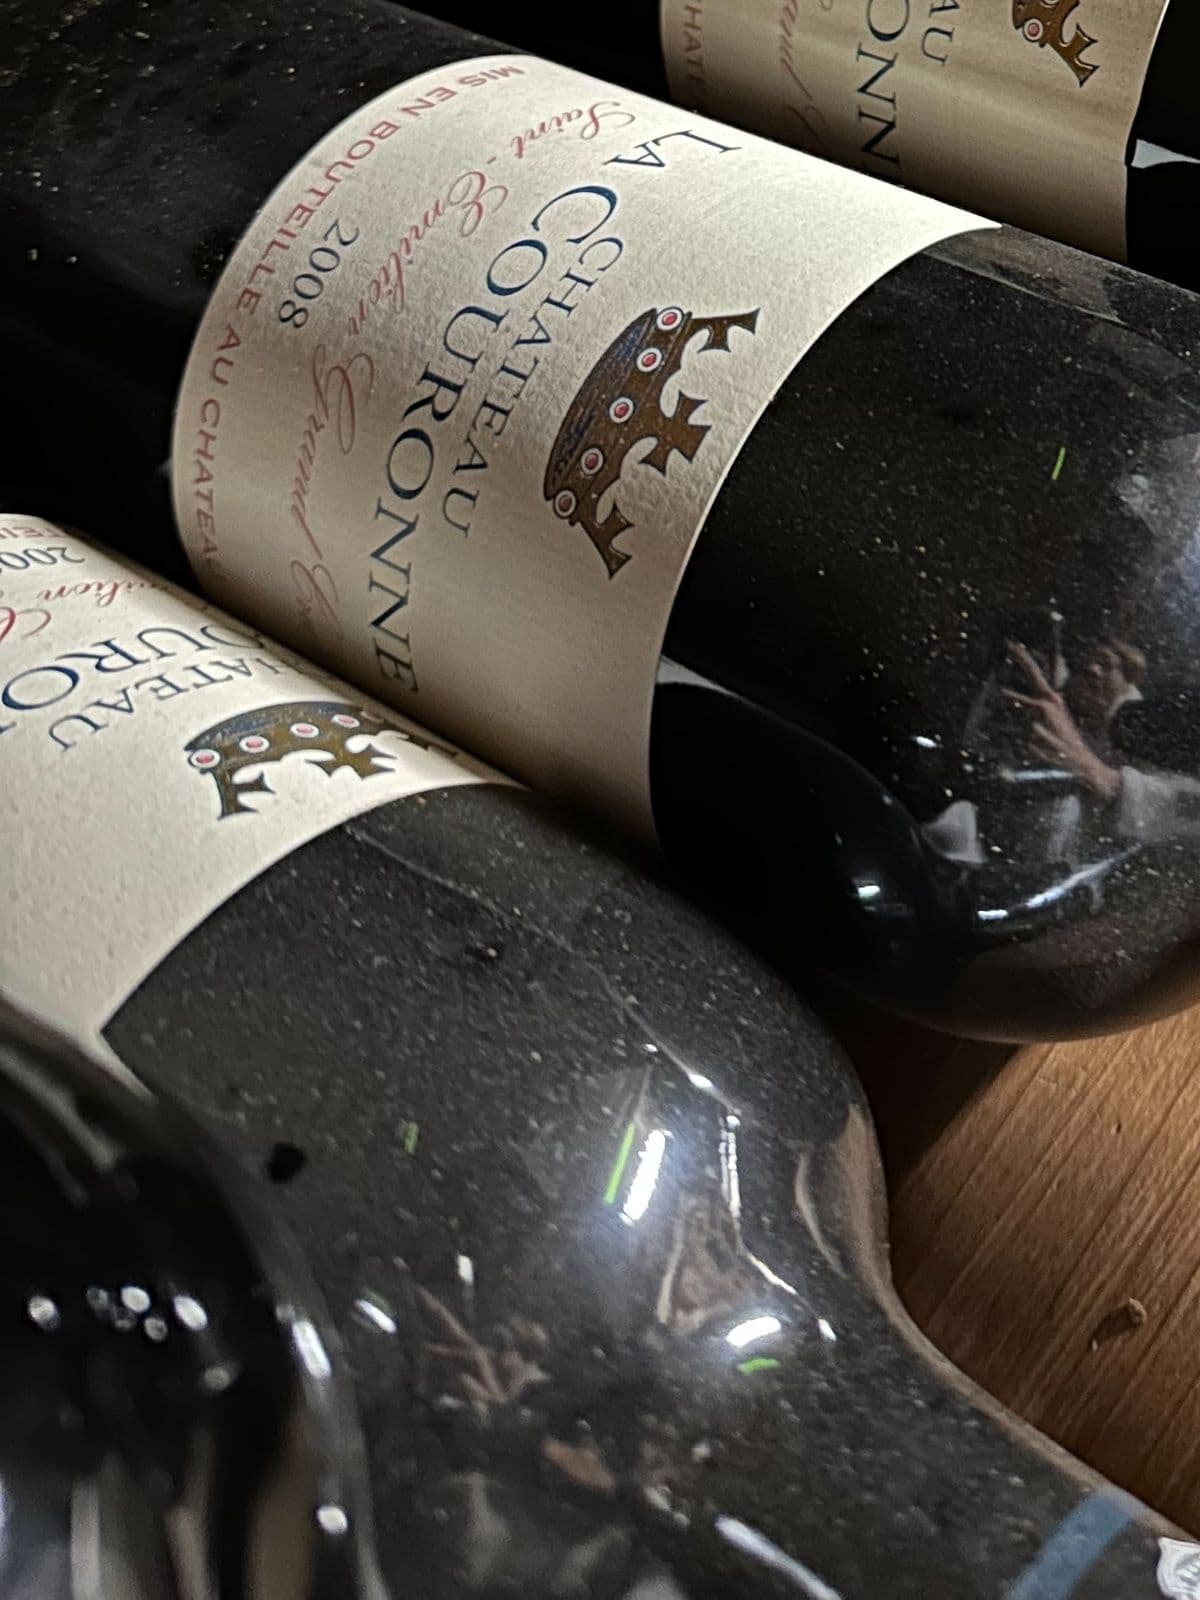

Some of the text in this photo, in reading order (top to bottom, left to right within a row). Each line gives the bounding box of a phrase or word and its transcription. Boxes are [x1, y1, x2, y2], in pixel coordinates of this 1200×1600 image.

[400, 84, 459, 119] EN
[464, 64, 525, 89] MIS
[510, 101, 637, 159] Saint
[236, 120, 401, 309] BOUTEILLE
[344, 170, 509, 338] Emilien
[277, 220, 360, 329] 2008
[211, 323, 242, 386] AU
[442, 237, 625, 538] CHATEAU
[292, 344, 375, 561] Grand
[368, 129, 742, 691] LA COURONNE
[0, 546, 85, 573] 200
[48, 656, 283, 750] ATEAU
